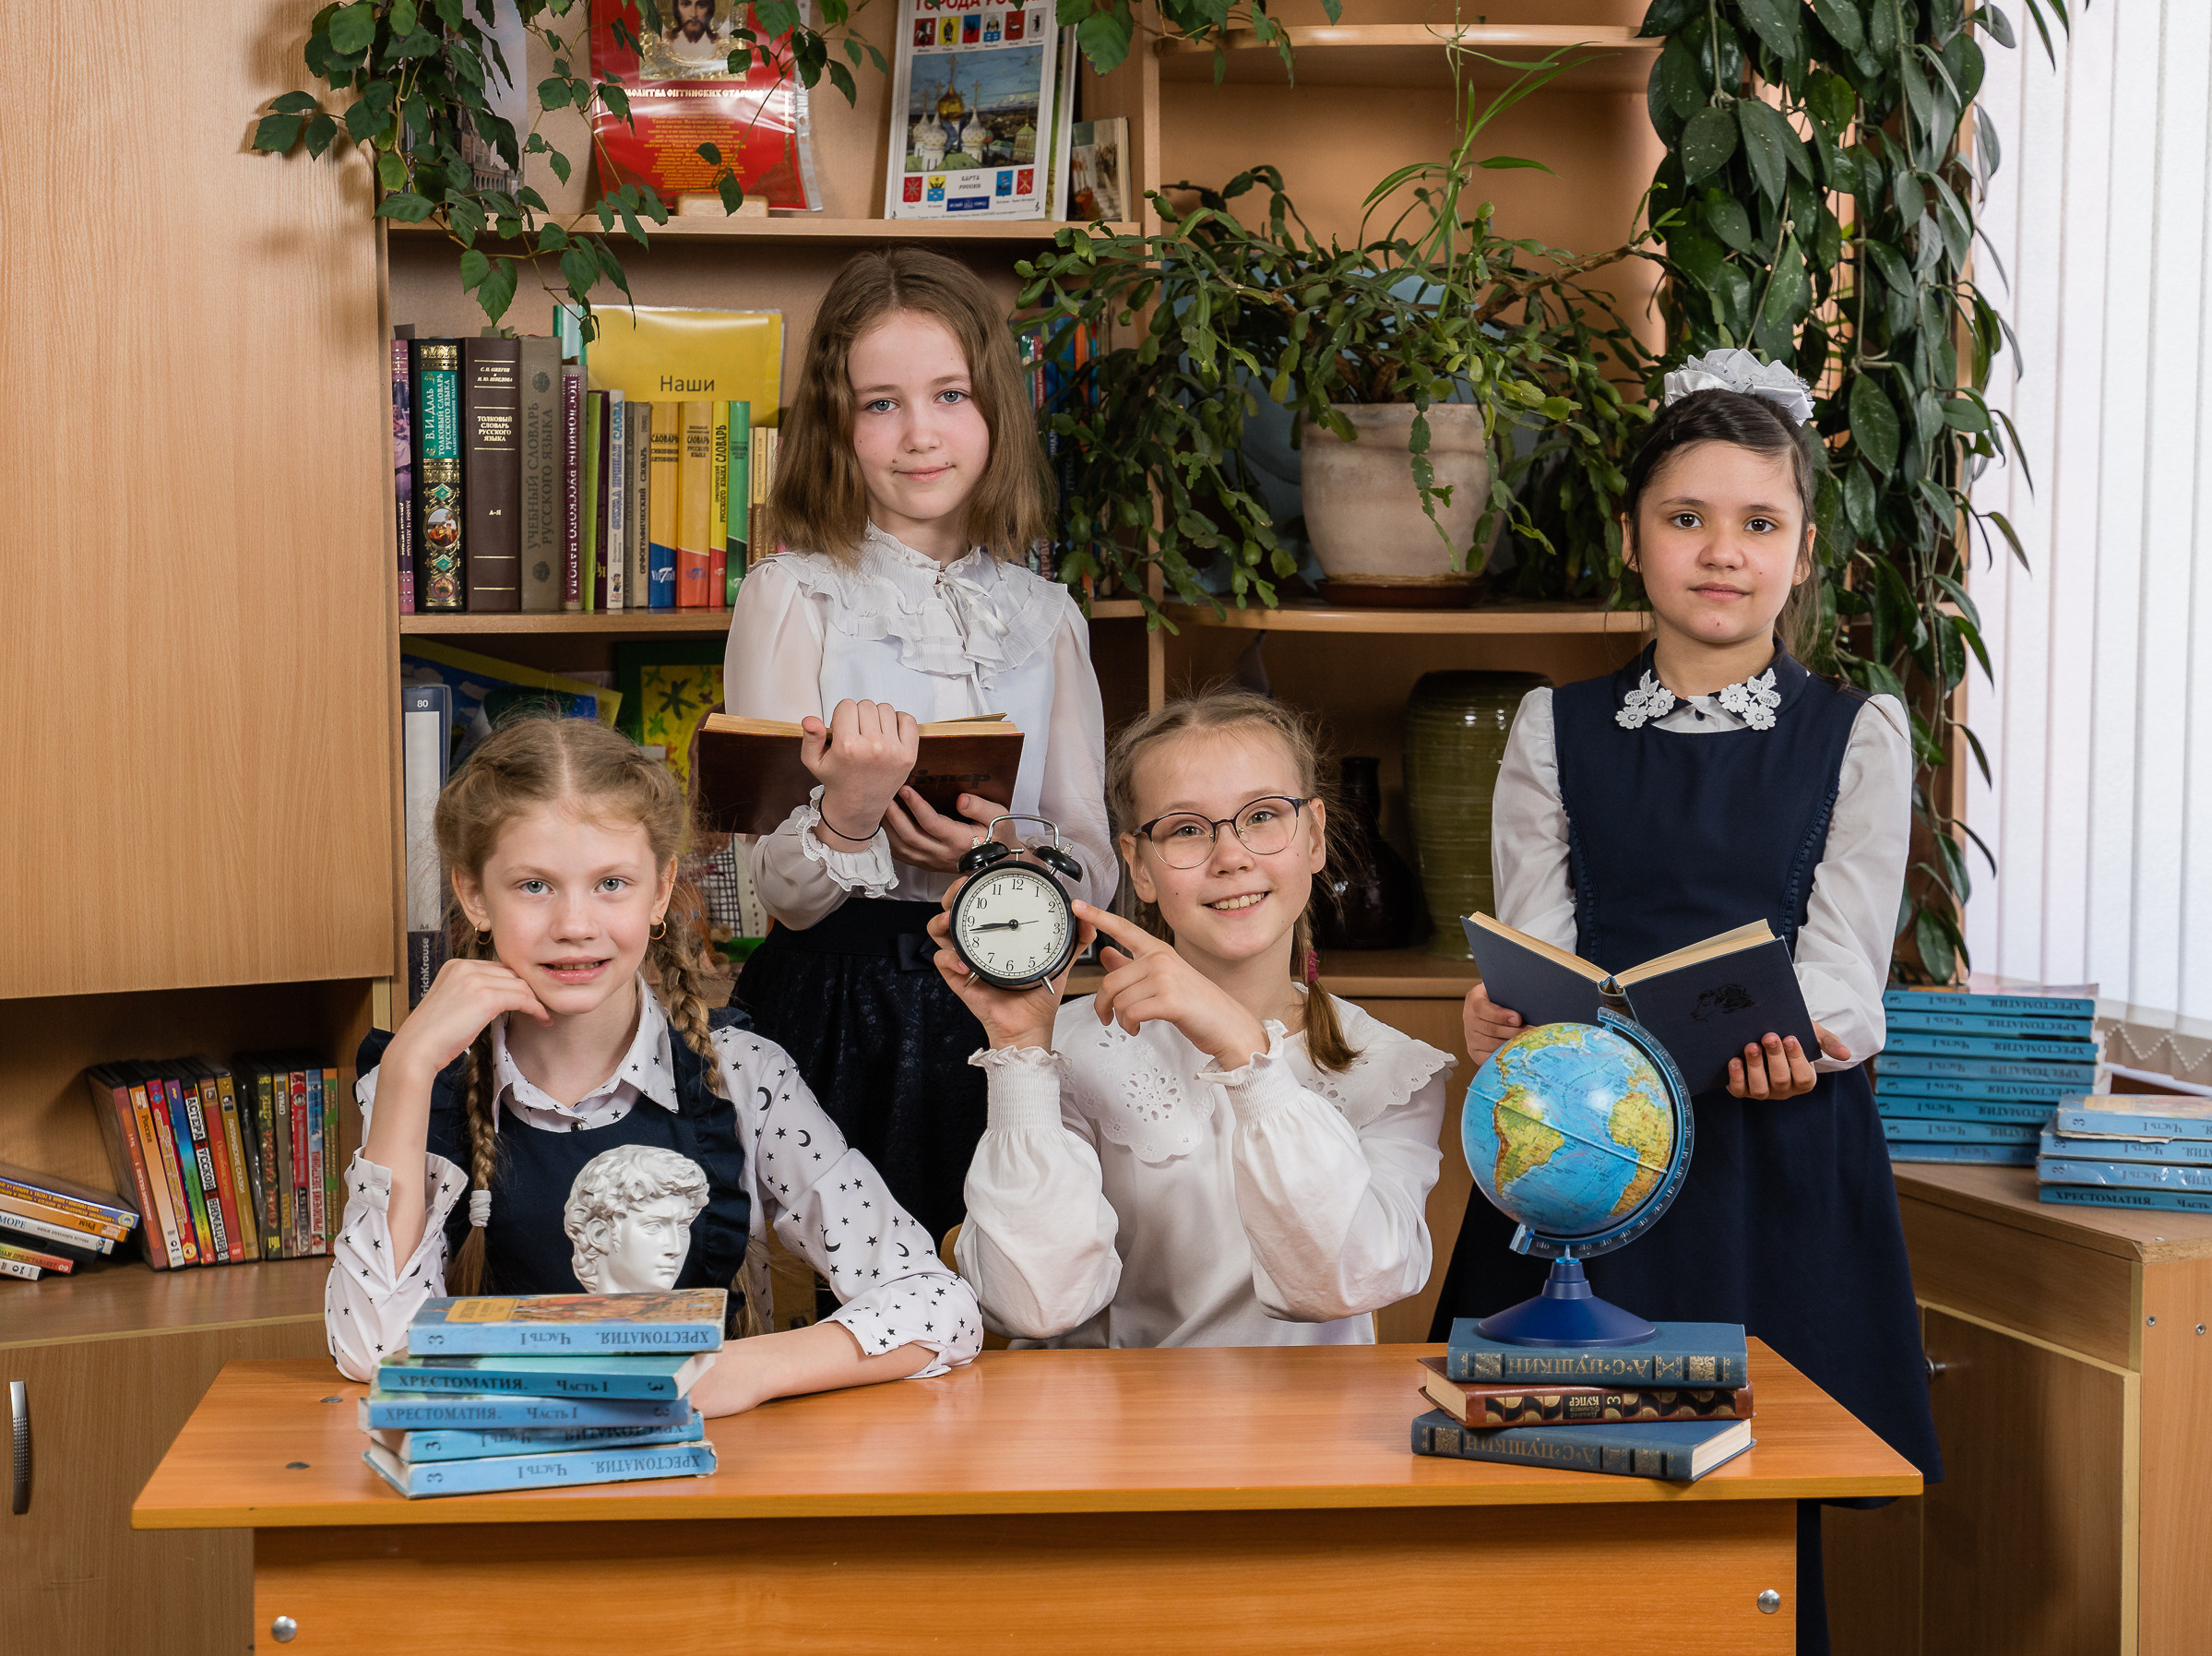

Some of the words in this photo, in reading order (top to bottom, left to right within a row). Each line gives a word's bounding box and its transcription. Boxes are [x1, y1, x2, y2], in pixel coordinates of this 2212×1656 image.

[660, 375, 716, 392] Наши
[612, 400, 624, 441] СЛОВА
[445, 408, 453, 451] РУССКОГО
[528, 402, 539, 471] СЛОВАРЬ
[541, 409, 553, 460] ЯЗЫКА
[686, 435, 709, 445] СЛОВАРЬ
[716, 424, 727, 462] СЛОВАРЬ
[541, 465, 553, 544] РУССКОГО
[567, 470, 577, 539] РУССКОГО
[526, 475, 541, 550] УЧЕБНЫЙ
[638, 488, 648, 575] ОРФОГРАФИЧЕСКИЙ
[568, 542, 578, 595] НАРОДА
[416, 697, 429, 709] 80
[992, 884, 1002, 896] 11
[1011, 878, 1024, 890] 12
[976, 898, 988, 910] 10
[1048, 901, 1056, 913] 2
[968, 916, 975, 927] 9
[1053, 923, 1061, 935] 3
[971, 936, 980, 948] 8
[1043, 942, 1052, 954] 4
[987, 953, 995, 963] 7
[1005, 960, 1014, 971] 6
[1028, 957, 1036, 968] 5
[141, 1114, 153, 1143] Россия
[2055, 1190, 2156, 1206] ХРЕСТОМАТИЯ.
[596, 1330, 709, 1345] ХРЕСТОМАТИЯ.
[398, 1375, 528, 1390] ХРЕСТОМАТИЯ.
[1606, 1395, 1621, 1405] 3
[385, 1407, 502, 1421] ХРЕСТОМАТИЯ.
[590, 1455, 701, 1473] ХРЕСТОМАТИЯ.
